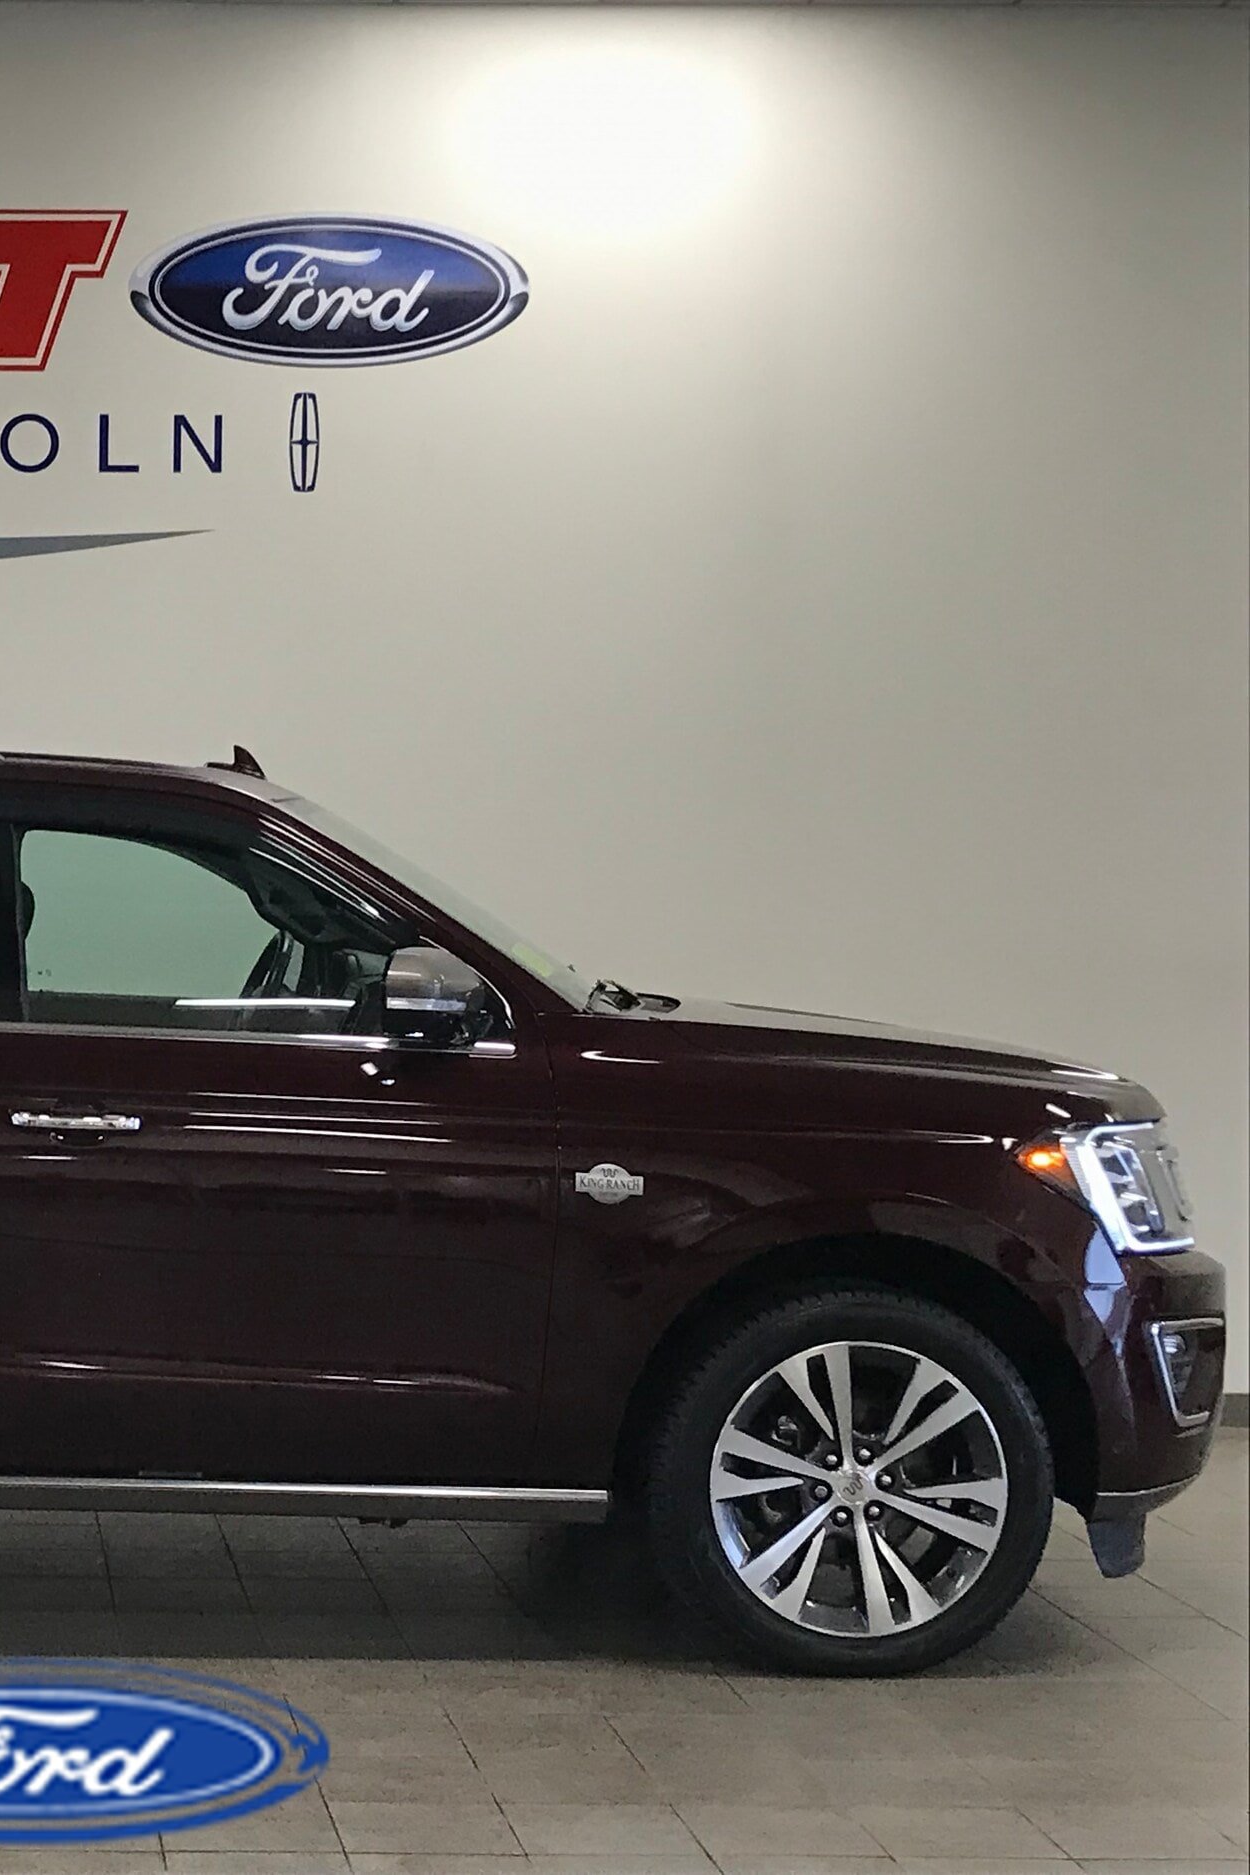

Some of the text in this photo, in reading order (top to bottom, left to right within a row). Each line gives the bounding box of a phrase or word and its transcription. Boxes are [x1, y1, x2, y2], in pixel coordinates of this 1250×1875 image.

[220, 244, 431, 335] Ford
[579, 1175, 640, 1191] KING RANCH
